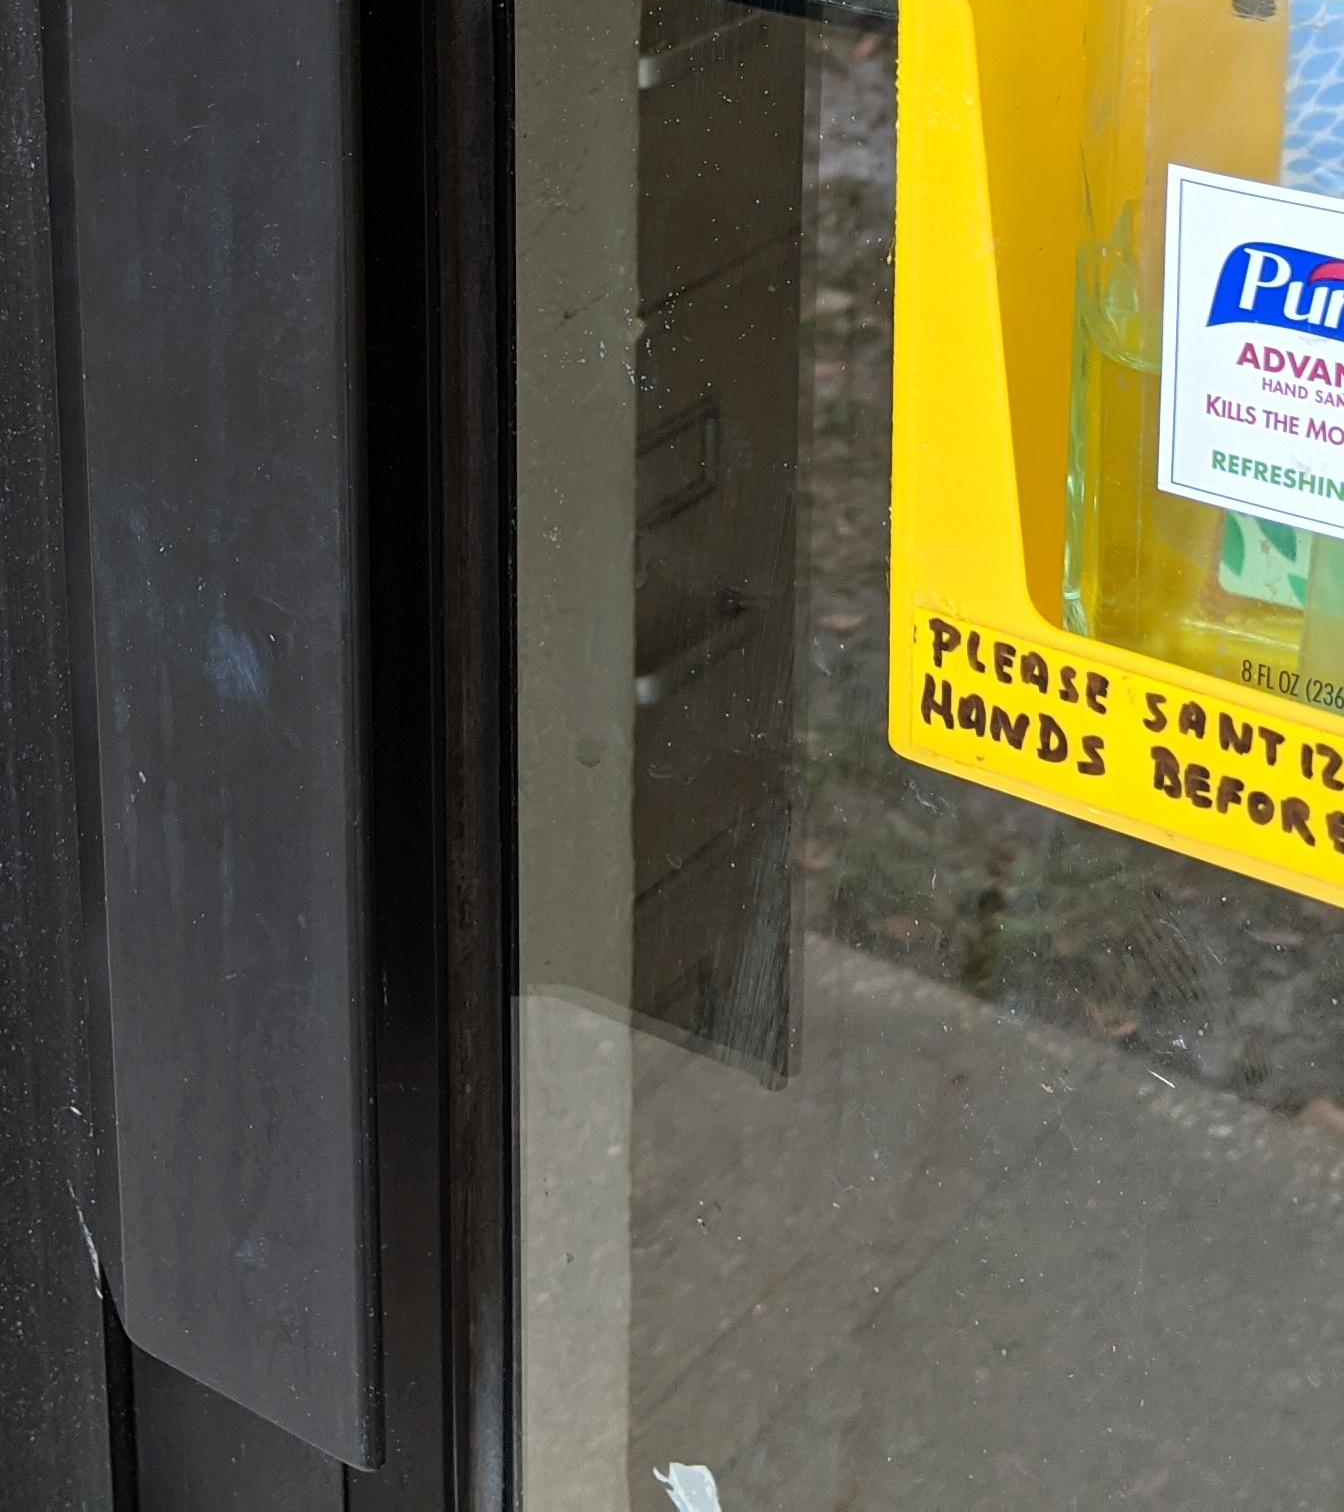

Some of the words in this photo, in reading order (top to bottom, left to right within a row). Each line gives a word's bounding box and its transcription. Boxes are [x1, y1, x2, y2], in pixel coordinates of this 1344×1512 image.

[1261, 377, 1309, 400] HAND
[1205, 393, 1257, 426] KILLS
[1262, 408, 1300, 436] THE
[927, 616, 1111, 715] PLEASE
[1241, 659, 1252, 683] 8
[1257, 663, 1274, 690] FL
[1278, 670, 1301, 697] OZ
[1306, 678, 1344, 710] (236
[920, 672, 1107, 777] HANDS
